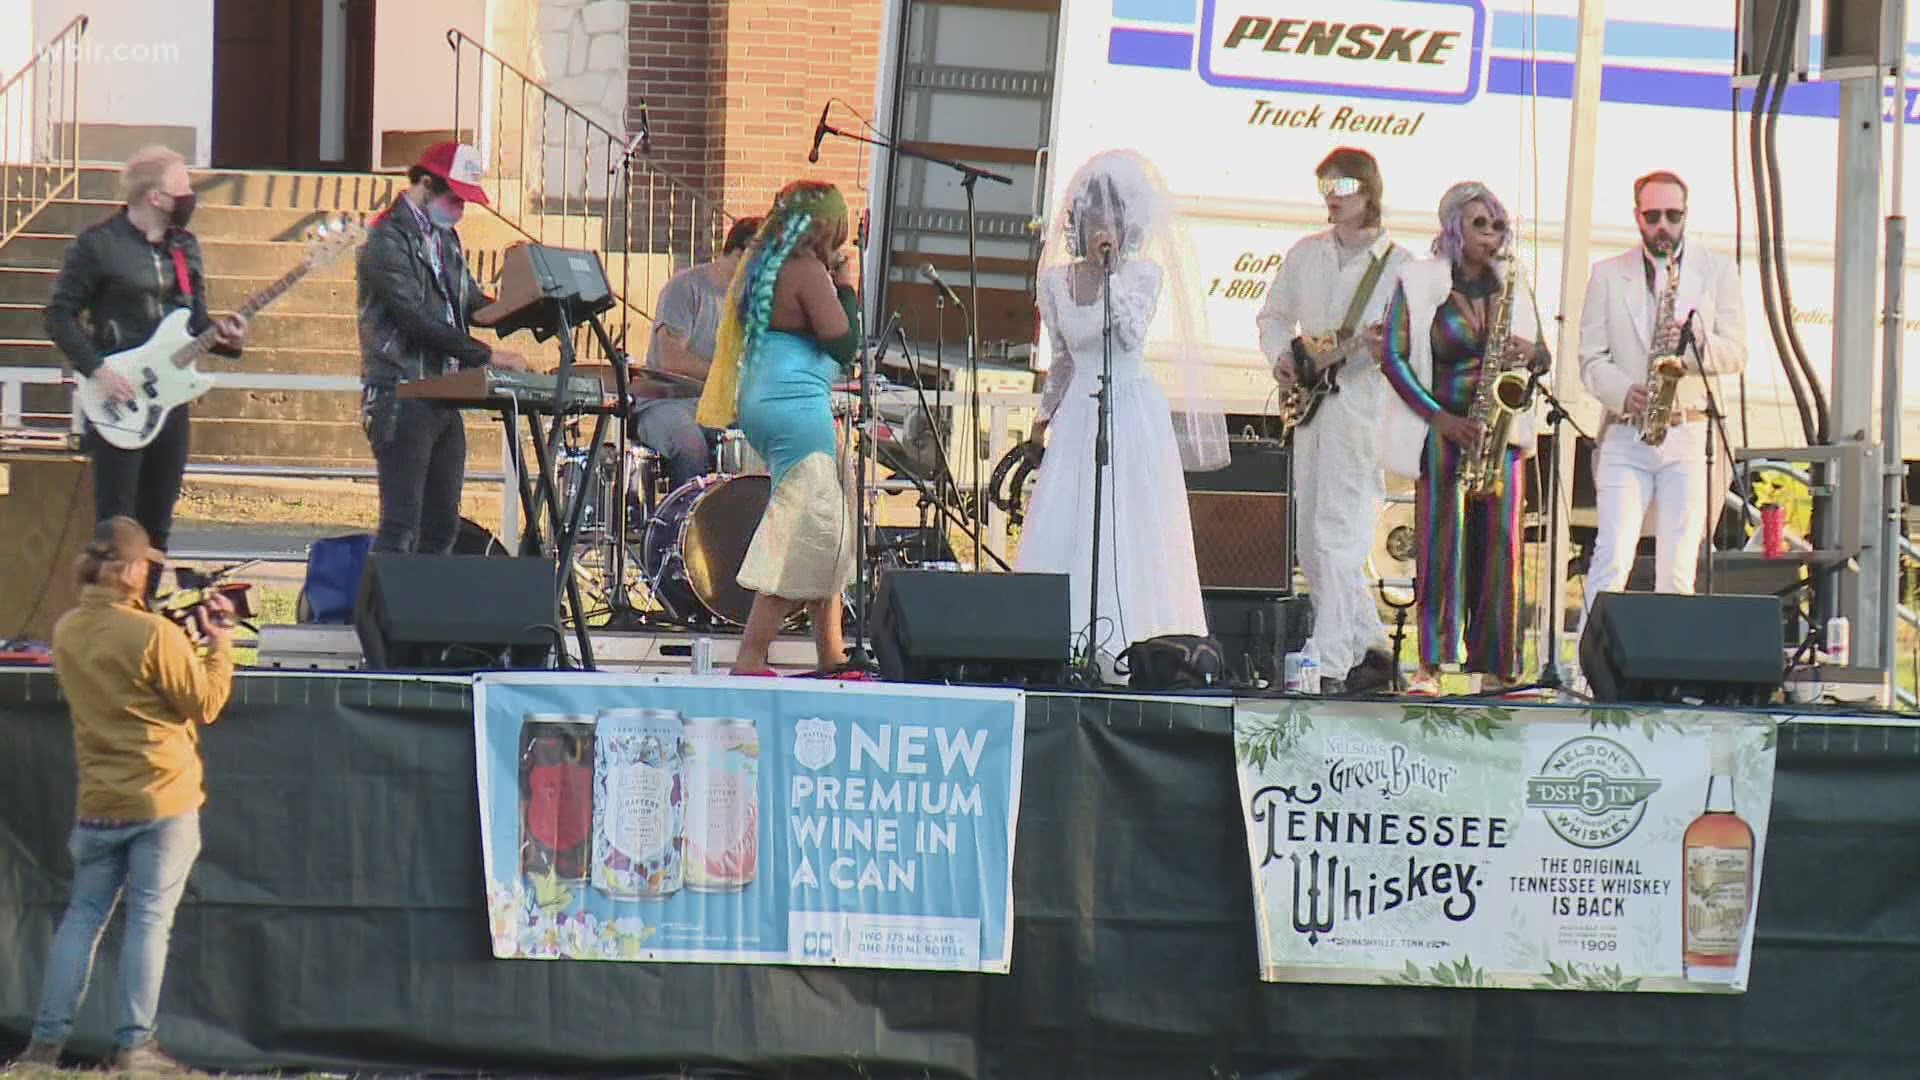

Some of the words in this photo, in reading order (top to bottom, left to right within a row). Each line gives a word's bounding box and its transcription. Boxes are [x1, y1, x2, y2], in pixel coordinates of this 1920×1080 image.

[1223, 15, 1461, 65] PENSKE
[1248, 99, 1324, 129] Truck
[1329, 106, 1425, 137] Rental
[850, 720, 989, 777] NEW
[791, 775, 983, 817] PREMIUM
[1537, 784, 1581, 801] DSP
[1582, 775, 1604, 811] 5
[1605, 785, 1635, 801] TN
[791, 815, 899, 852] WINE
[915, 821, 957, 857] IN
[1251, 783, 1508, 868] TENNESSEE
[1557, 813, 1630, 841] WHISKEY
[791, 856, 819, 890] A
[829, 857, 916, 893] CAN
[1541, 857, 1569, 873] THE
[1573, 858, 1642, 875] ORIGINAL
[1509, 876, 1596, 893] TENNESSEE
[1601, 878, 1671, 896] WHISKEY
[1552, 896, 1570, 916] IS
[1577, 897, 1625, 917] BACK
[1581, 939, 1617, 952] 1909
